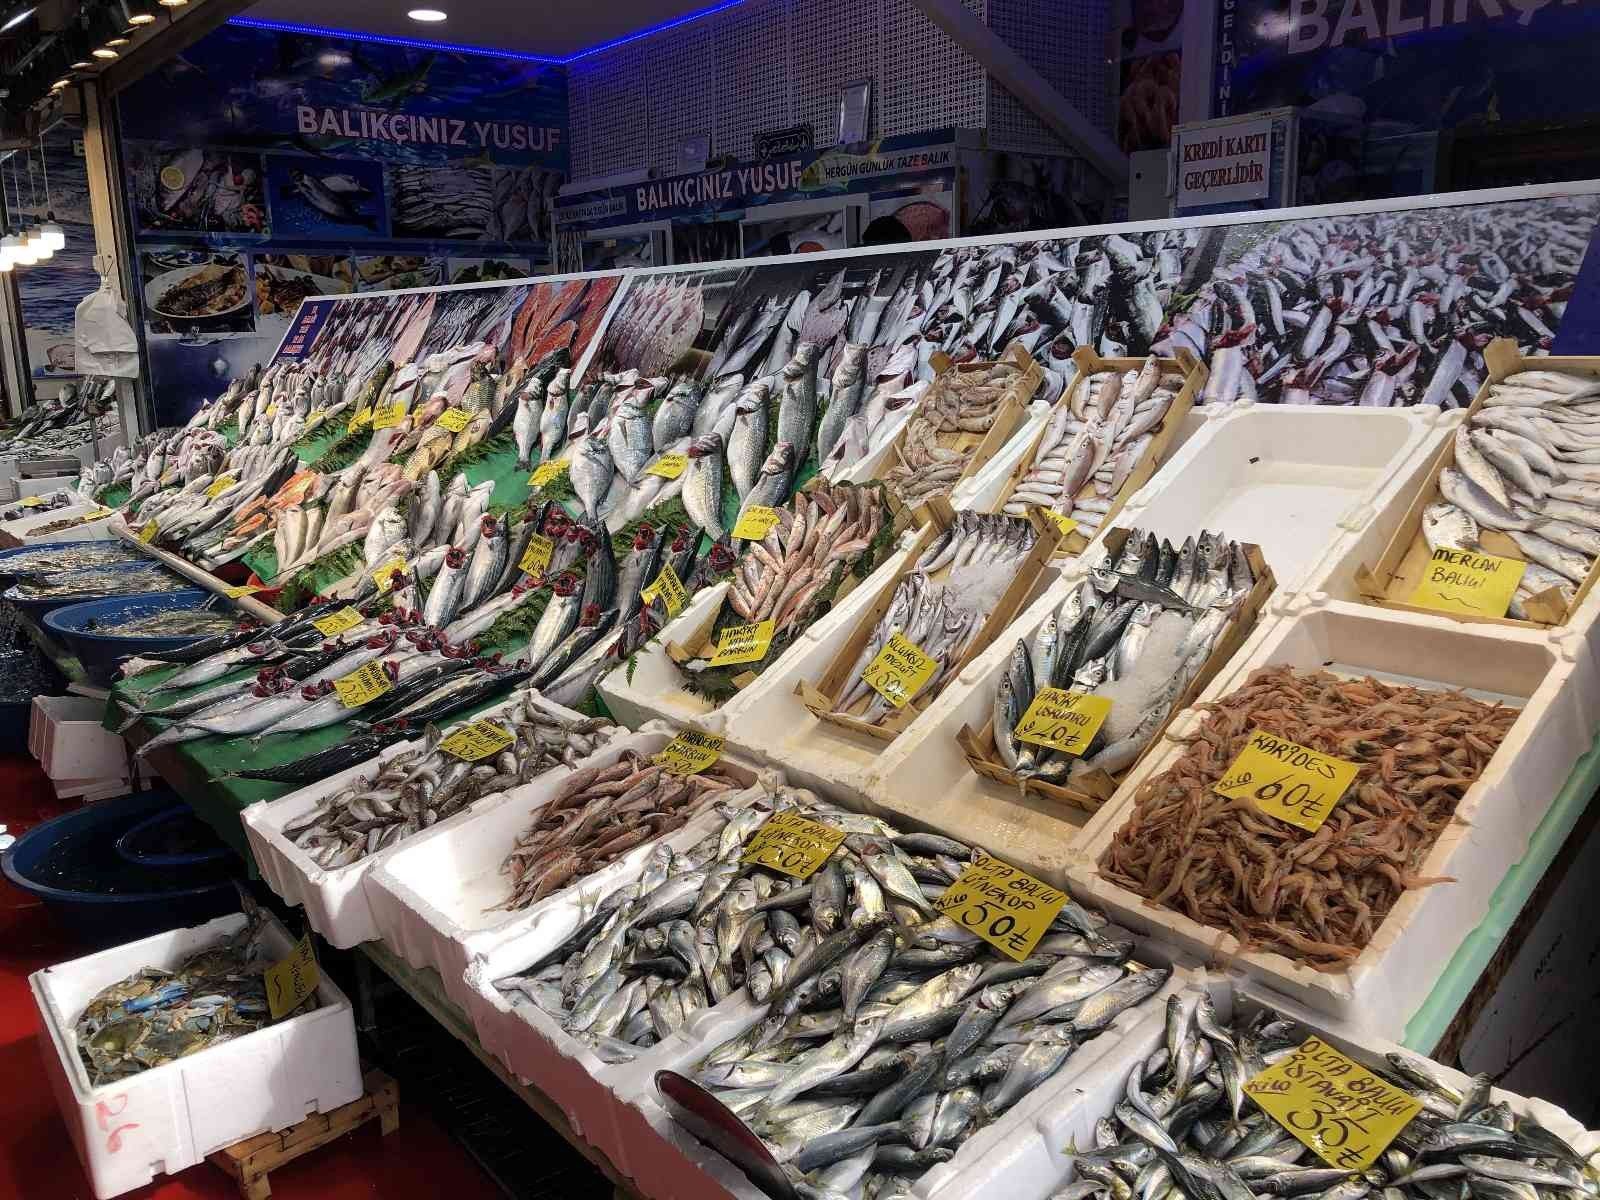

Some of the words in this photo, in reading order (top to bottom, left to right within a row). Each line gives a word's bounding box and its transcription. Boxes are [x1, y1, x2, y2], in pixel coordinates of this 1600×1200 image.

[296, 105, 467, 145] BALIKÇINIZ
[472, 121, 561, 151] YUSUF
[1183, 136, 1224, 163] KREDİ
[1225, 132, 1268, 157] KARTI
[737, 160, 802, 196] YUSUF
[825, 160, 858, 179] HERGÜN
[897, 153, 920, 168] TAZE
[921, 150, 949, 166] BALIK
[1184, 160, 1264, 192] GEÇERLİDİR
[974, 857, 1014, 879] OLTA
[1298, 1040, 1353, 1077] OLTA
